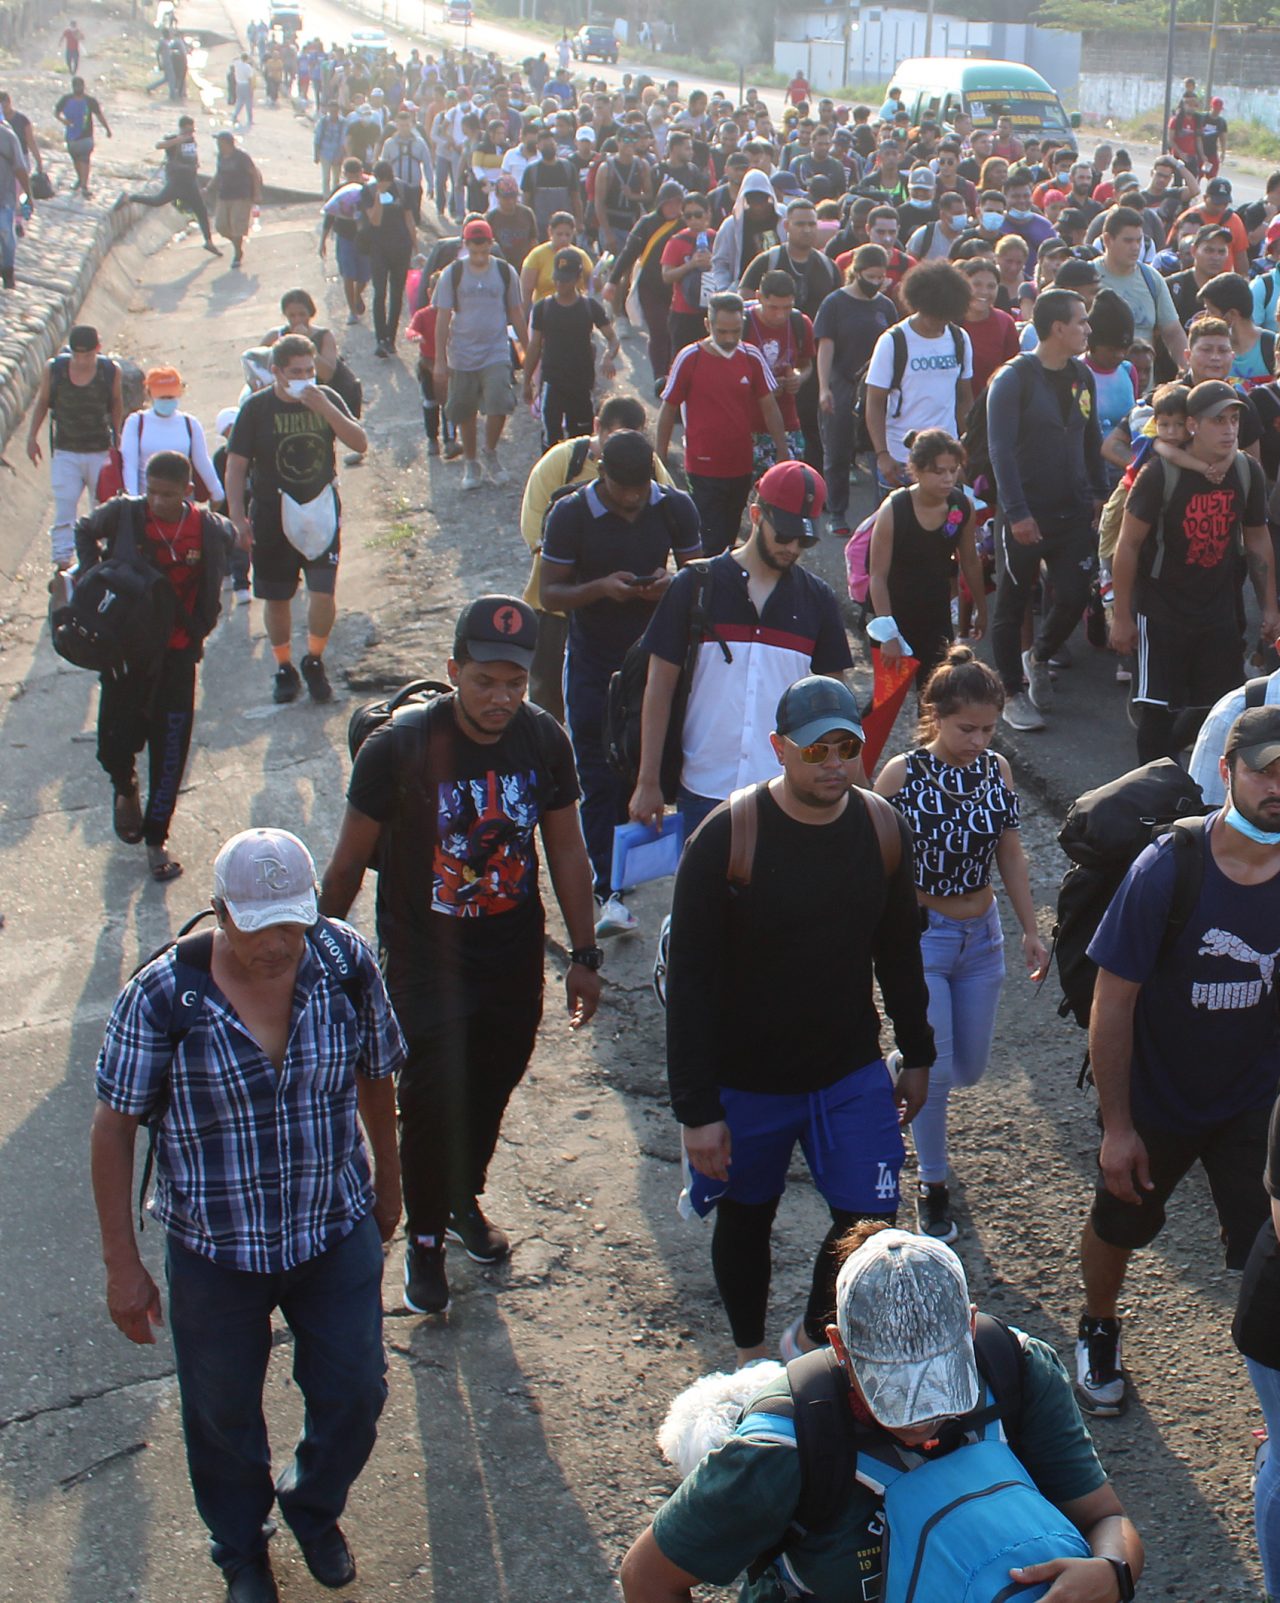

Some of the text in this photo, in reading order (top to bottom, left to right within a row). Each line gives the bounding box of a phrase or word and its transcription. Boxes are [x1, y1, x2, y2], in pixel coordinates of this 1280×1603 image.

[272, 411, 328, 434] NIRVAN
[1185, 491, 1234, 519] JUST
[319, 928, 348, 976] GAOBA
[1191, 979, 1263, 1011] PUMA
[875, 1162, 897, 1199] LA
